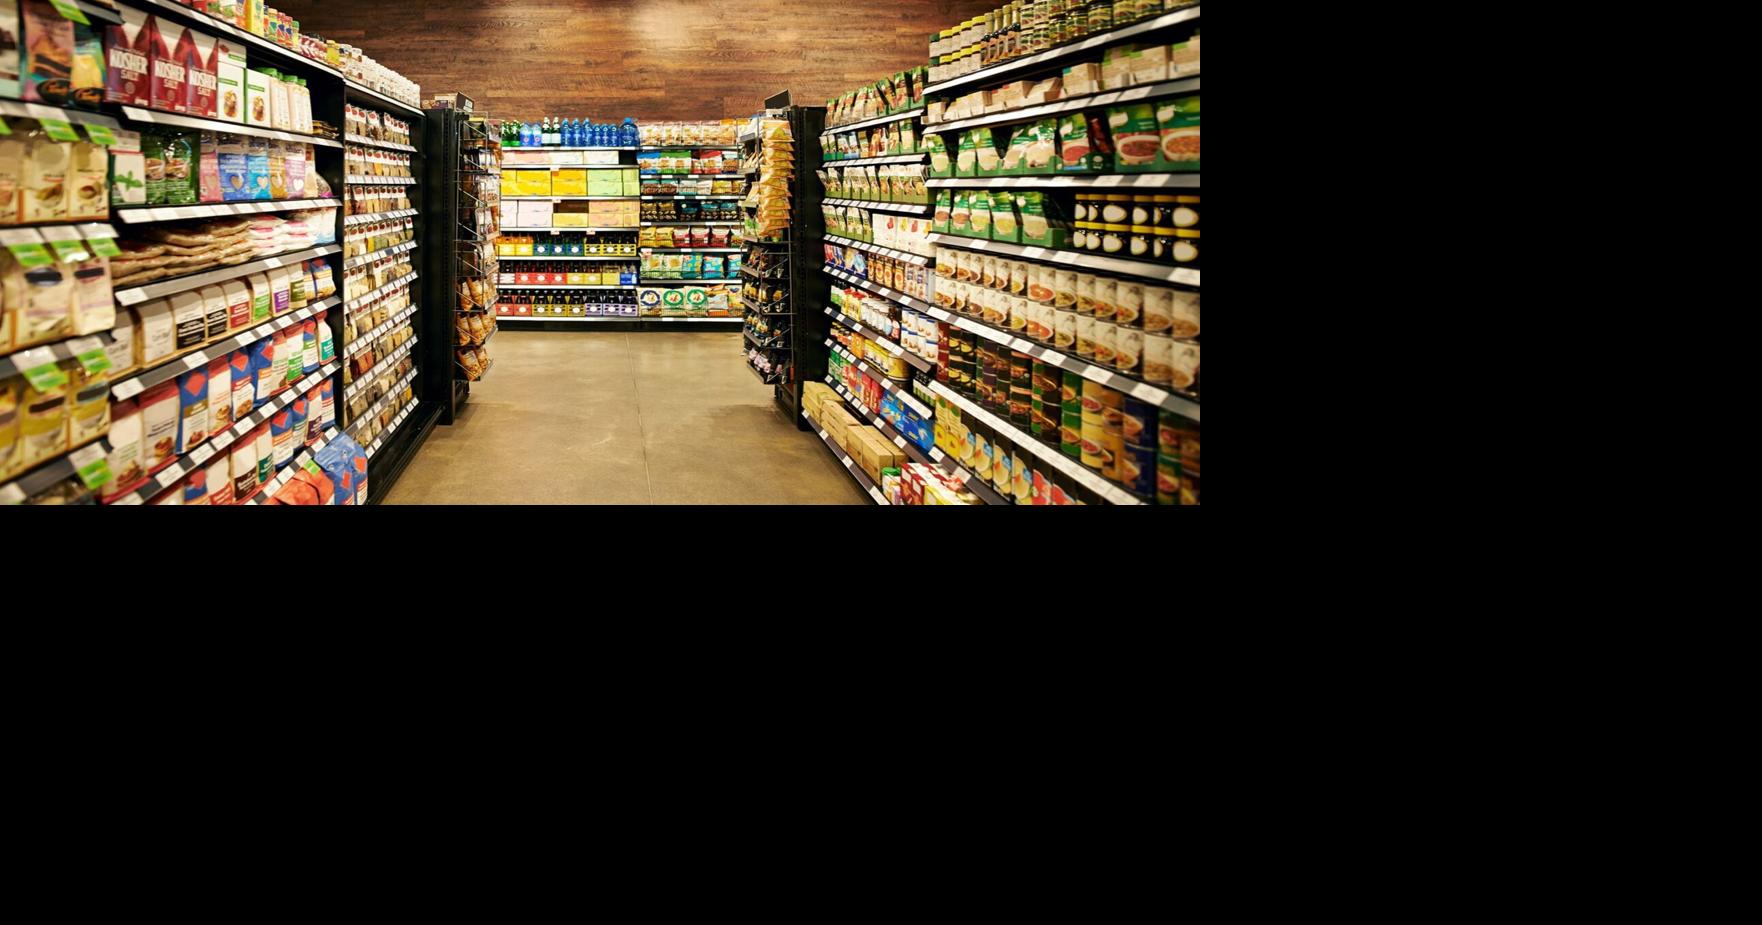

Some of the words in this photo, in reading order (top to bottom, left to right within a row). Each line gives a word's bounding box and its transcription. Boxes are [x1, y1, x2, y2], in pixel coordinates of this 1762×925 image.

[110, 48, 148, 75] KOSHER
[121, 70, 139, 81] SALT
[155, 60, 185, 83] KOSHER
[163, 79, 179, 90] SALT
[189, 69, 217, 91] KOSHER
[197, 86, 211, 97] SALT
